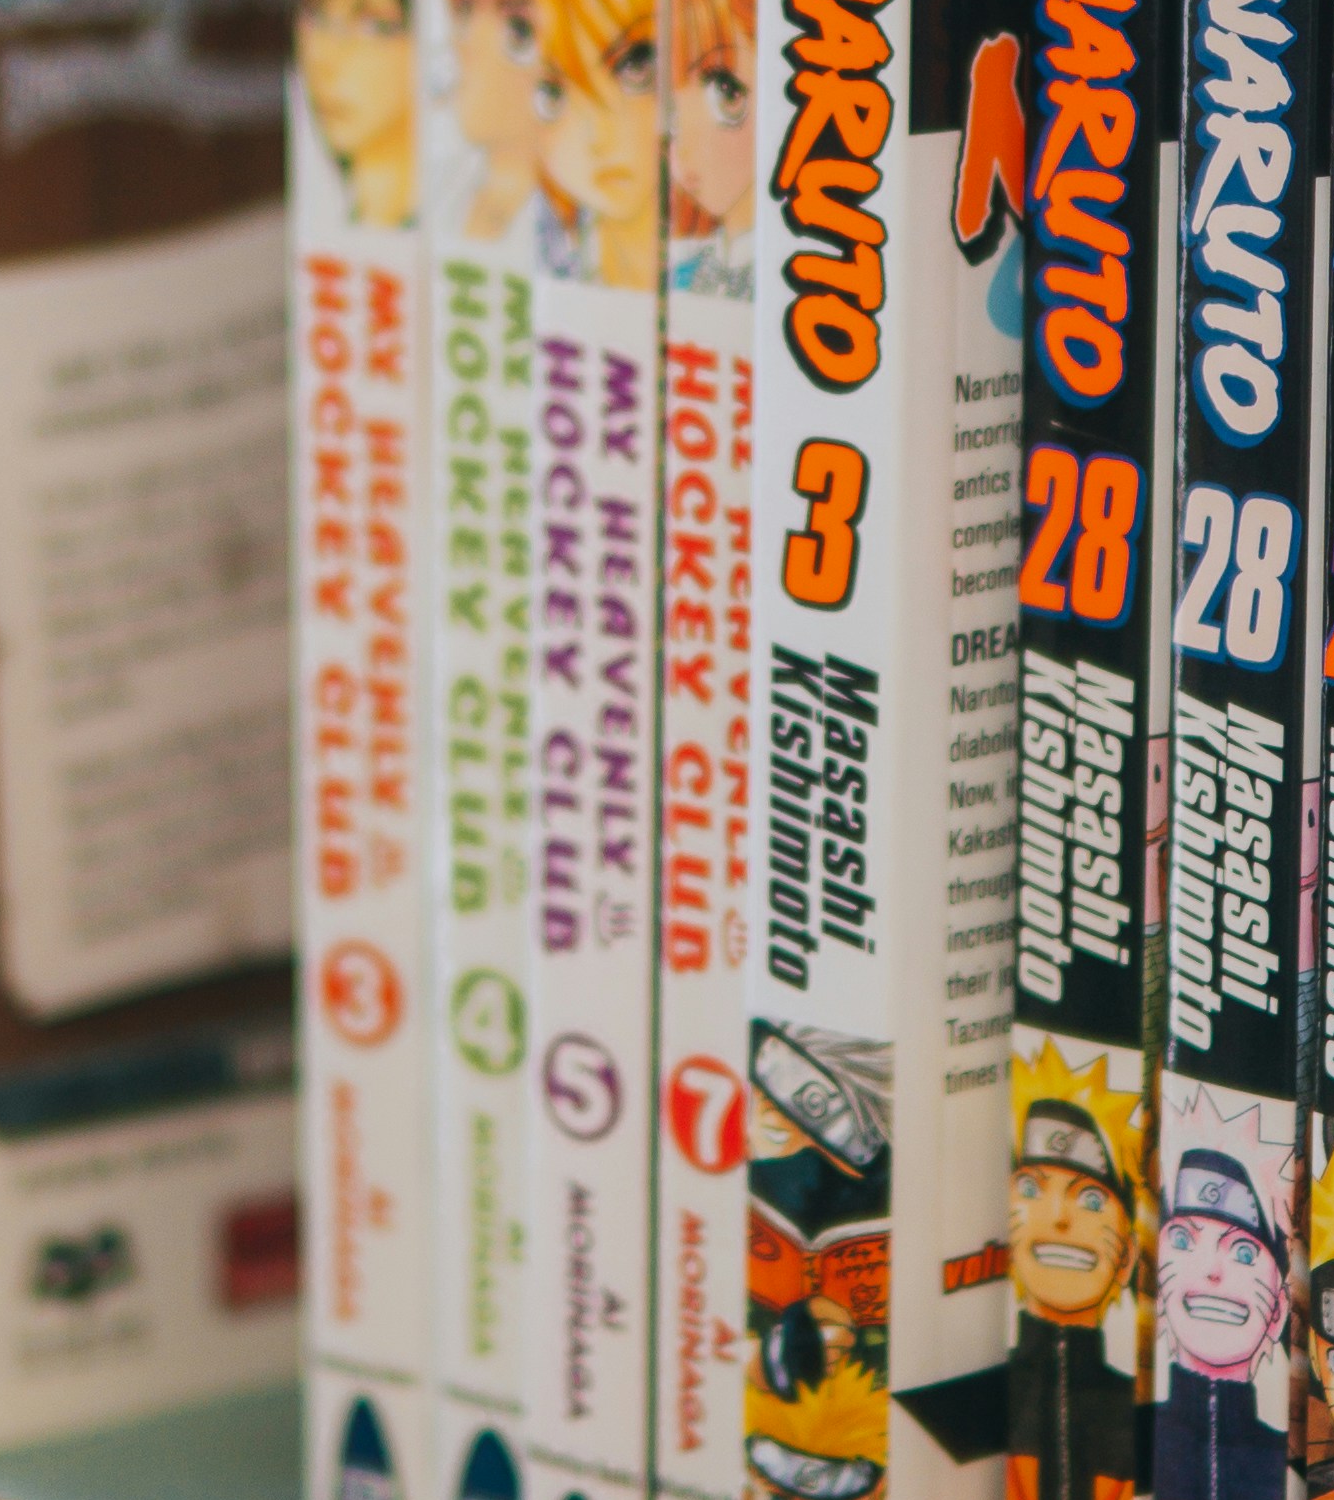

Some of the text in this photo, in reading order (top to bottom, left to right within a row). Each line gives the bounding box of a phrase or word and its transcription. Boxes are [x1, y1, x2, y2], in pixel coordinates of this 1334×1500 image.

[362, 266, 409, 811] MY HEAVENLY
[782, 436, 869, 613] 3
[953, 467, 1011, 502] antics
[954, 371, 1021, 404] Naruto
[1019, 443, 1142, 626] 28
[304, 253, 361, 900] HOCKEY CLUB
[442, 259, 491, 917] HOCKEY CLUB
[537, 335, 588, 957] HOCKEY CLUB
[596, 347, 642, 876] MY HEAVENLY
[666, 339, 720, 976] HOCKEY CLUB
[1174, 485, 1301, 671] 28
[765, 643, 827, 993] Kishimoto
[816, 654, 880, 957] Masashi
[949, 779, 998, 811] Now,
[1018, 650, 1077, 1004] Kishimoto
[1071, 659, 1135, 967] Masashi
[1173, 690, 1229, 1053] Kishimoto
[1221, 702, 1285, 1017] Masashi
